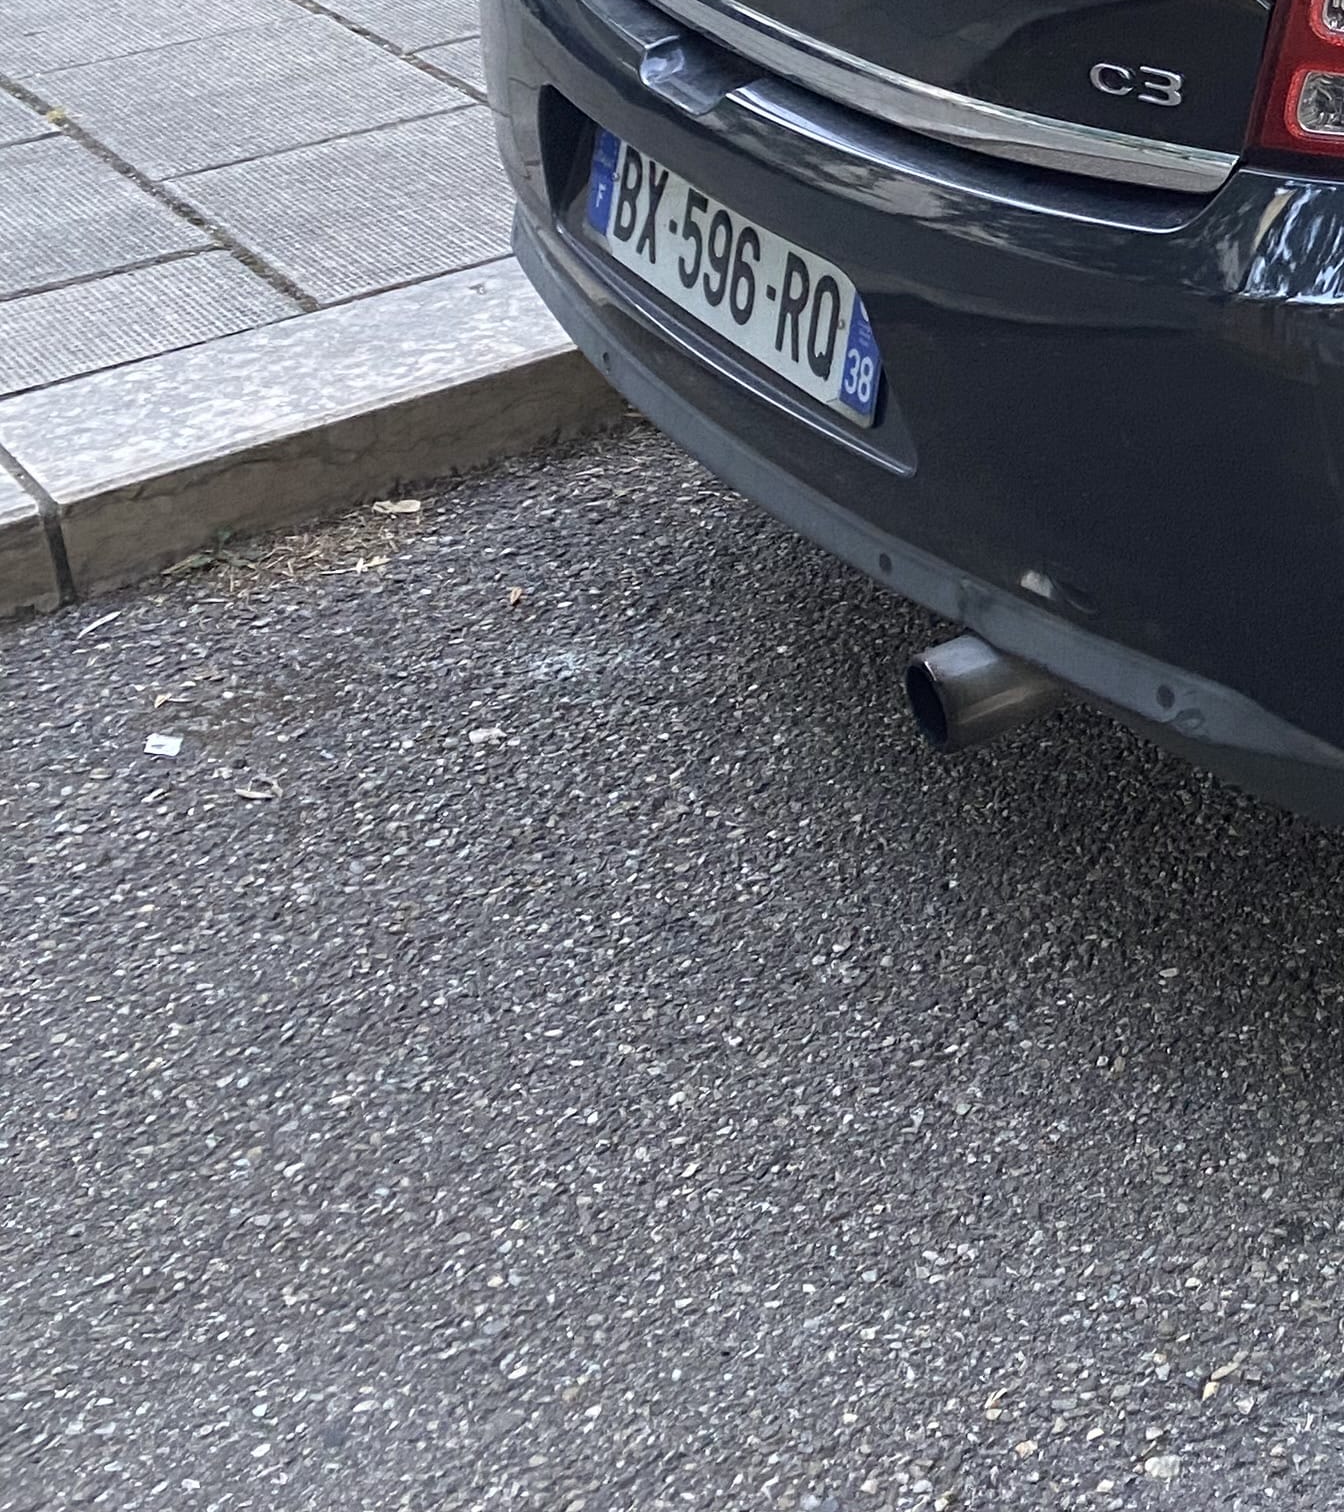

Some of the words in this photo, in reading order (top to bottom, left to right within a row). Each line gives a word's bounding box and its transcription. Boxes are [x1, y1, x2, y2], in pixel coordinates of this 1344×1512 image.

[1089, 63, 1182, 106] C3
[613, 144, 842, 382] BX-596-RQ
[844, 348, 875, 404] 38
